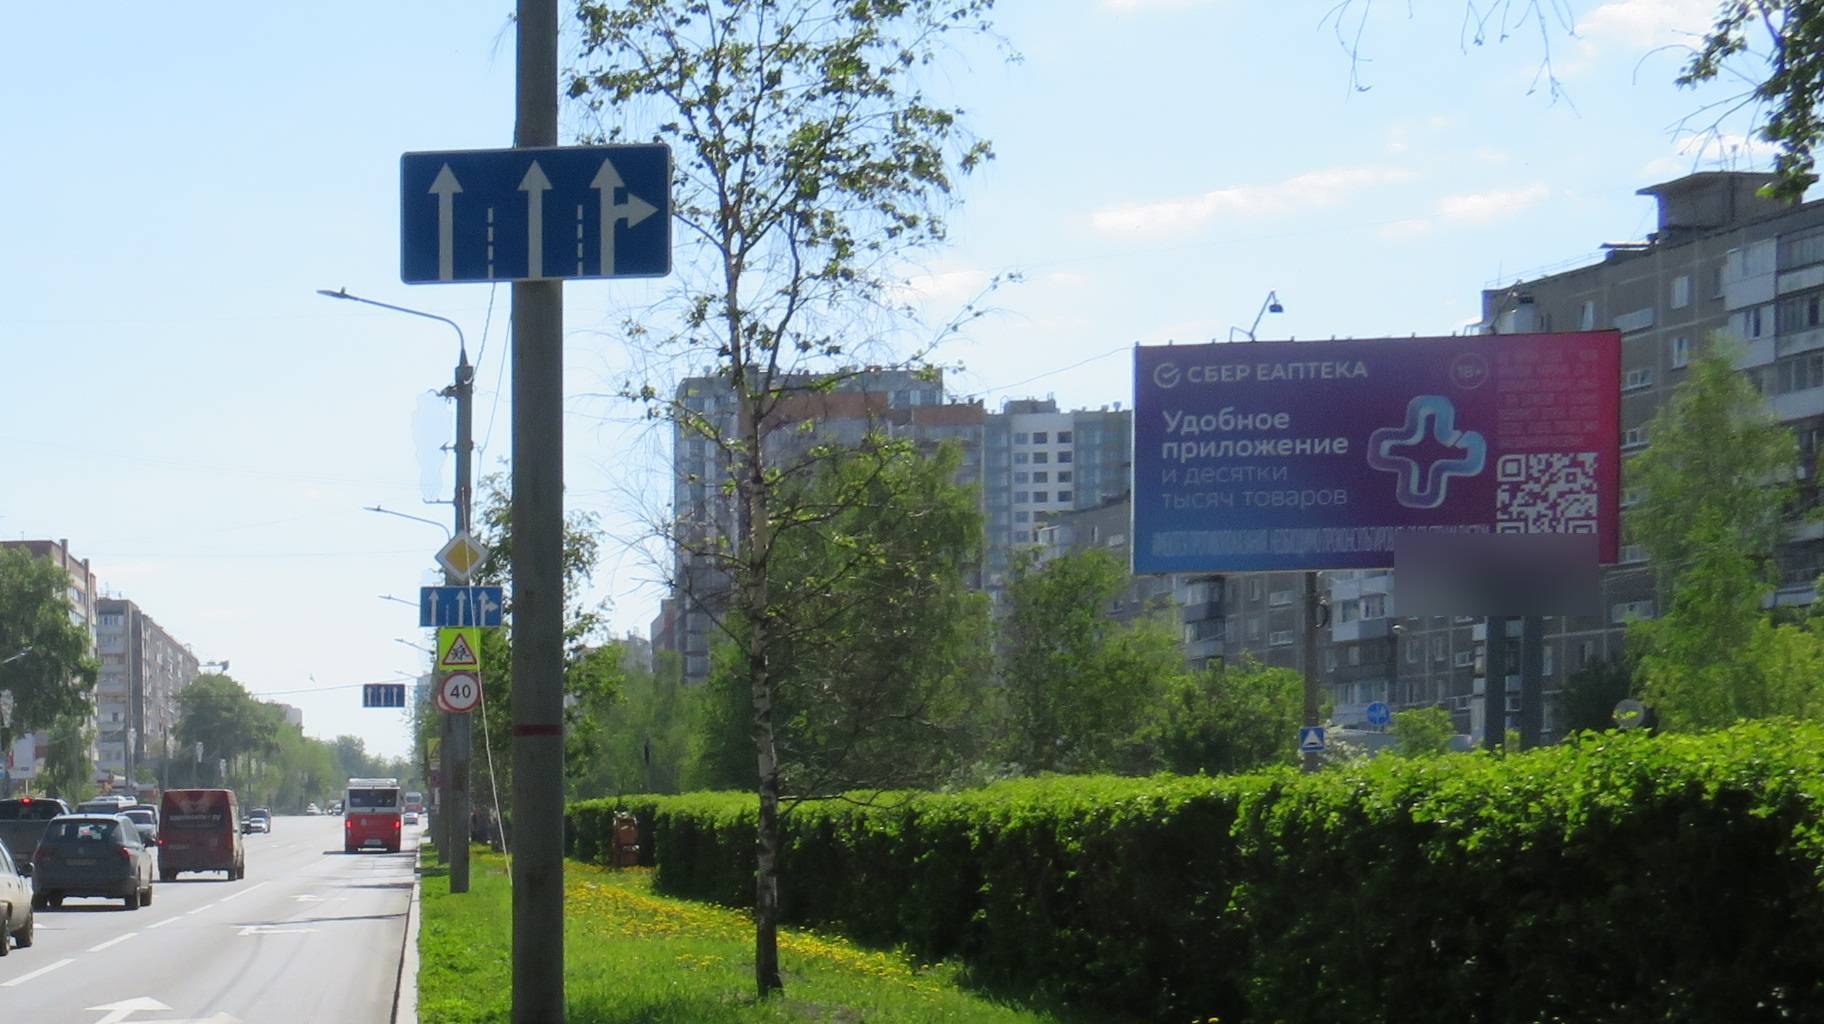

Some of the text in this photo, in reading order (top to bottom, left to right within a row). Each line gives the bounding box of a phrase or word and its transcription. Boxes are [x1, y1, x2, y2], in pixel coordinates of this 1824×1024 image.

[1187, 361, 1369, 384] СБЕР ЕАПТЕКА
[1161, 406, 1291, 436] Удобное
[1161, 436, 1350, 464] приложение
[1161, 465, 1288, 486] и десятки
[1161, 489, 1348, 510] тысяч товаров
[450, 684, 471, 699] 40
